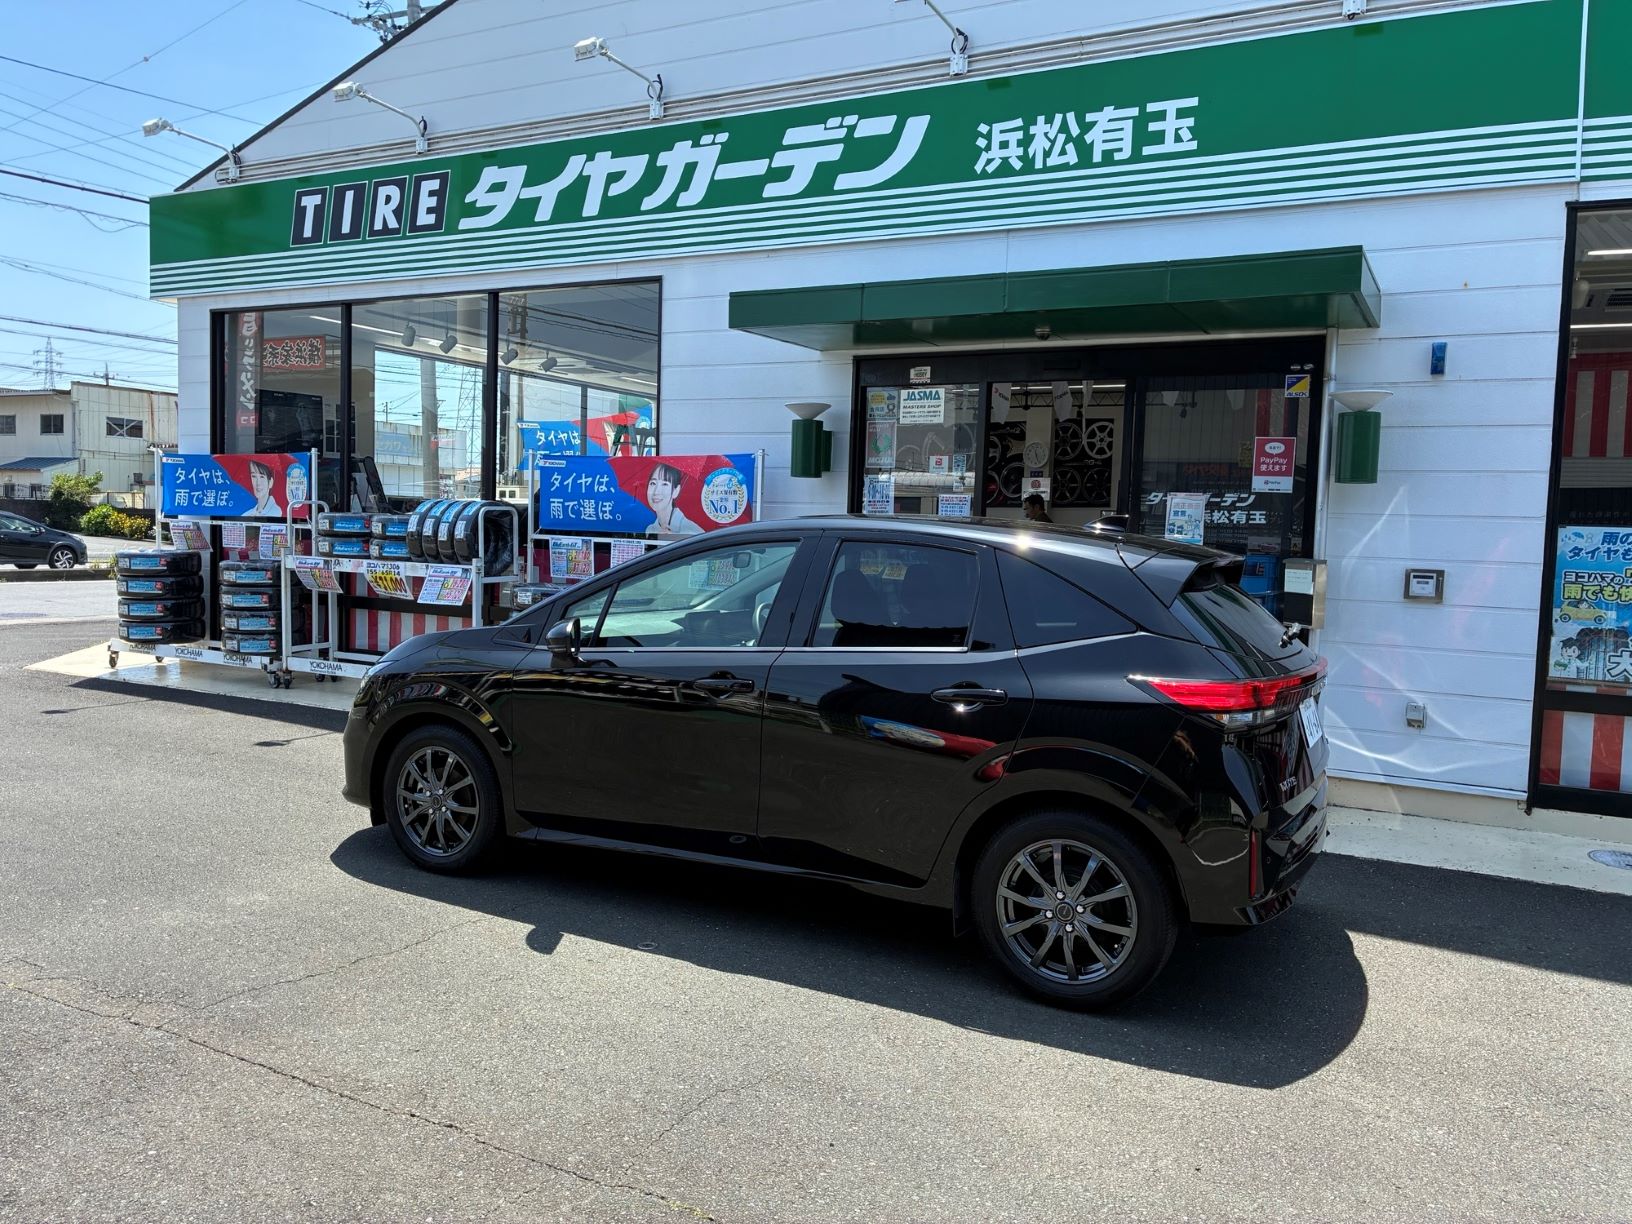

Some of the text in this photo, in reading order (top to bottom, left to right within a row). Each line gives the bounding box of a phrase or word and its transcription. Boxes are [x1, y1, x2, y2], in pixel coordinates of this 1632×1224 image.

[299, 97, 1199, 239] TIRE タイヤガーデン 浜松有玉
[903, 390, 941, 401] JASMA
[1260, 456, 1287, 465] PayPay
[175, 467, 230, 485] タイヤは、
[550, 472, 615, 493] タイヤは、
[175, 488, 234, 507] 雨で選ぼ。
[550, 498, 622, 521] 雨で選ぼ。
[709, 499, 738, 514] No.1
[1564, 571, 1624, 585] ヨコハマの
[175, 648, 203, 657] YOKOHAMA
[223, 654, 252, 664] YOKOHAMA
[310, 661, 342, 672] YOKOHAMA
